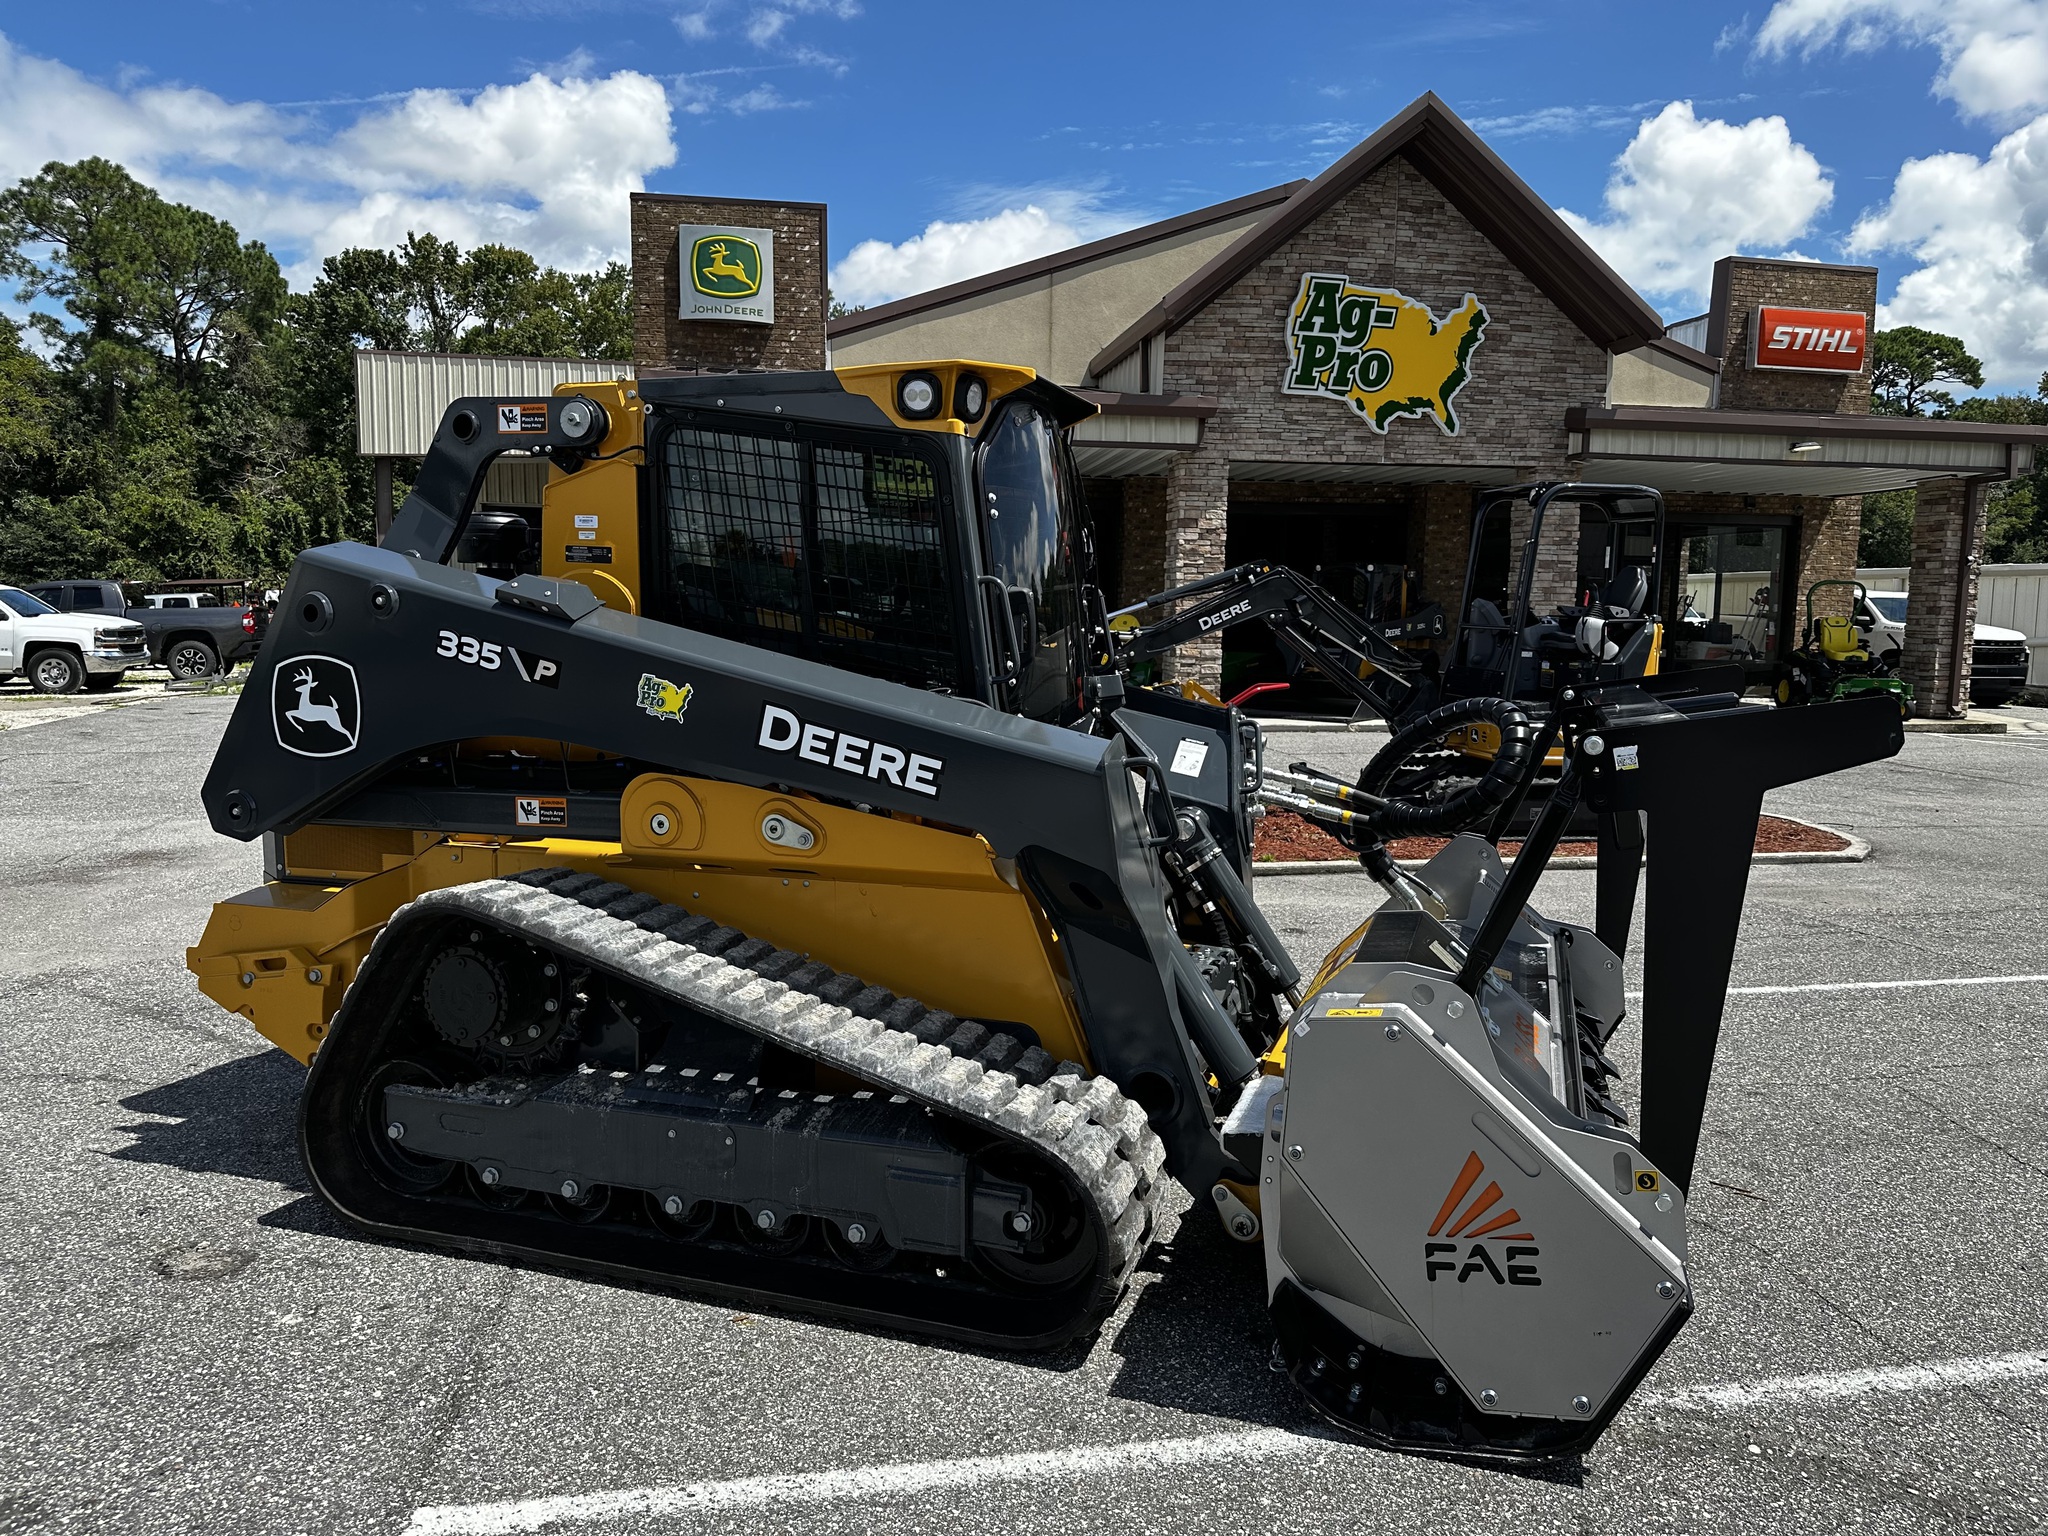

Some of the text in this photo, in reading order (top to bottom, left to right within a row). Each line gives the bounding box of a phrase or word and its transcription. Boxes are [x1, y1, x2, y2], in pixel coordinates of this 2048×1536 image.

[691, 304, 764, 317] JOHN DEERE
[1293, 276, 1398, 349] Ag-
[1767, 325, 1858, 353] STIHL
[1289, 334, 1394, 393] Pro
[1198, 599, 1252, 631] DEERE
[1385, 628, 1401, 637] DEERE
[437, 630, 557, 681] 335 P
[639, 691, 666, 709] Pro
[758, 704, 943, 796] DEERE
[1425, 1243, 1542, 1286] FAE
